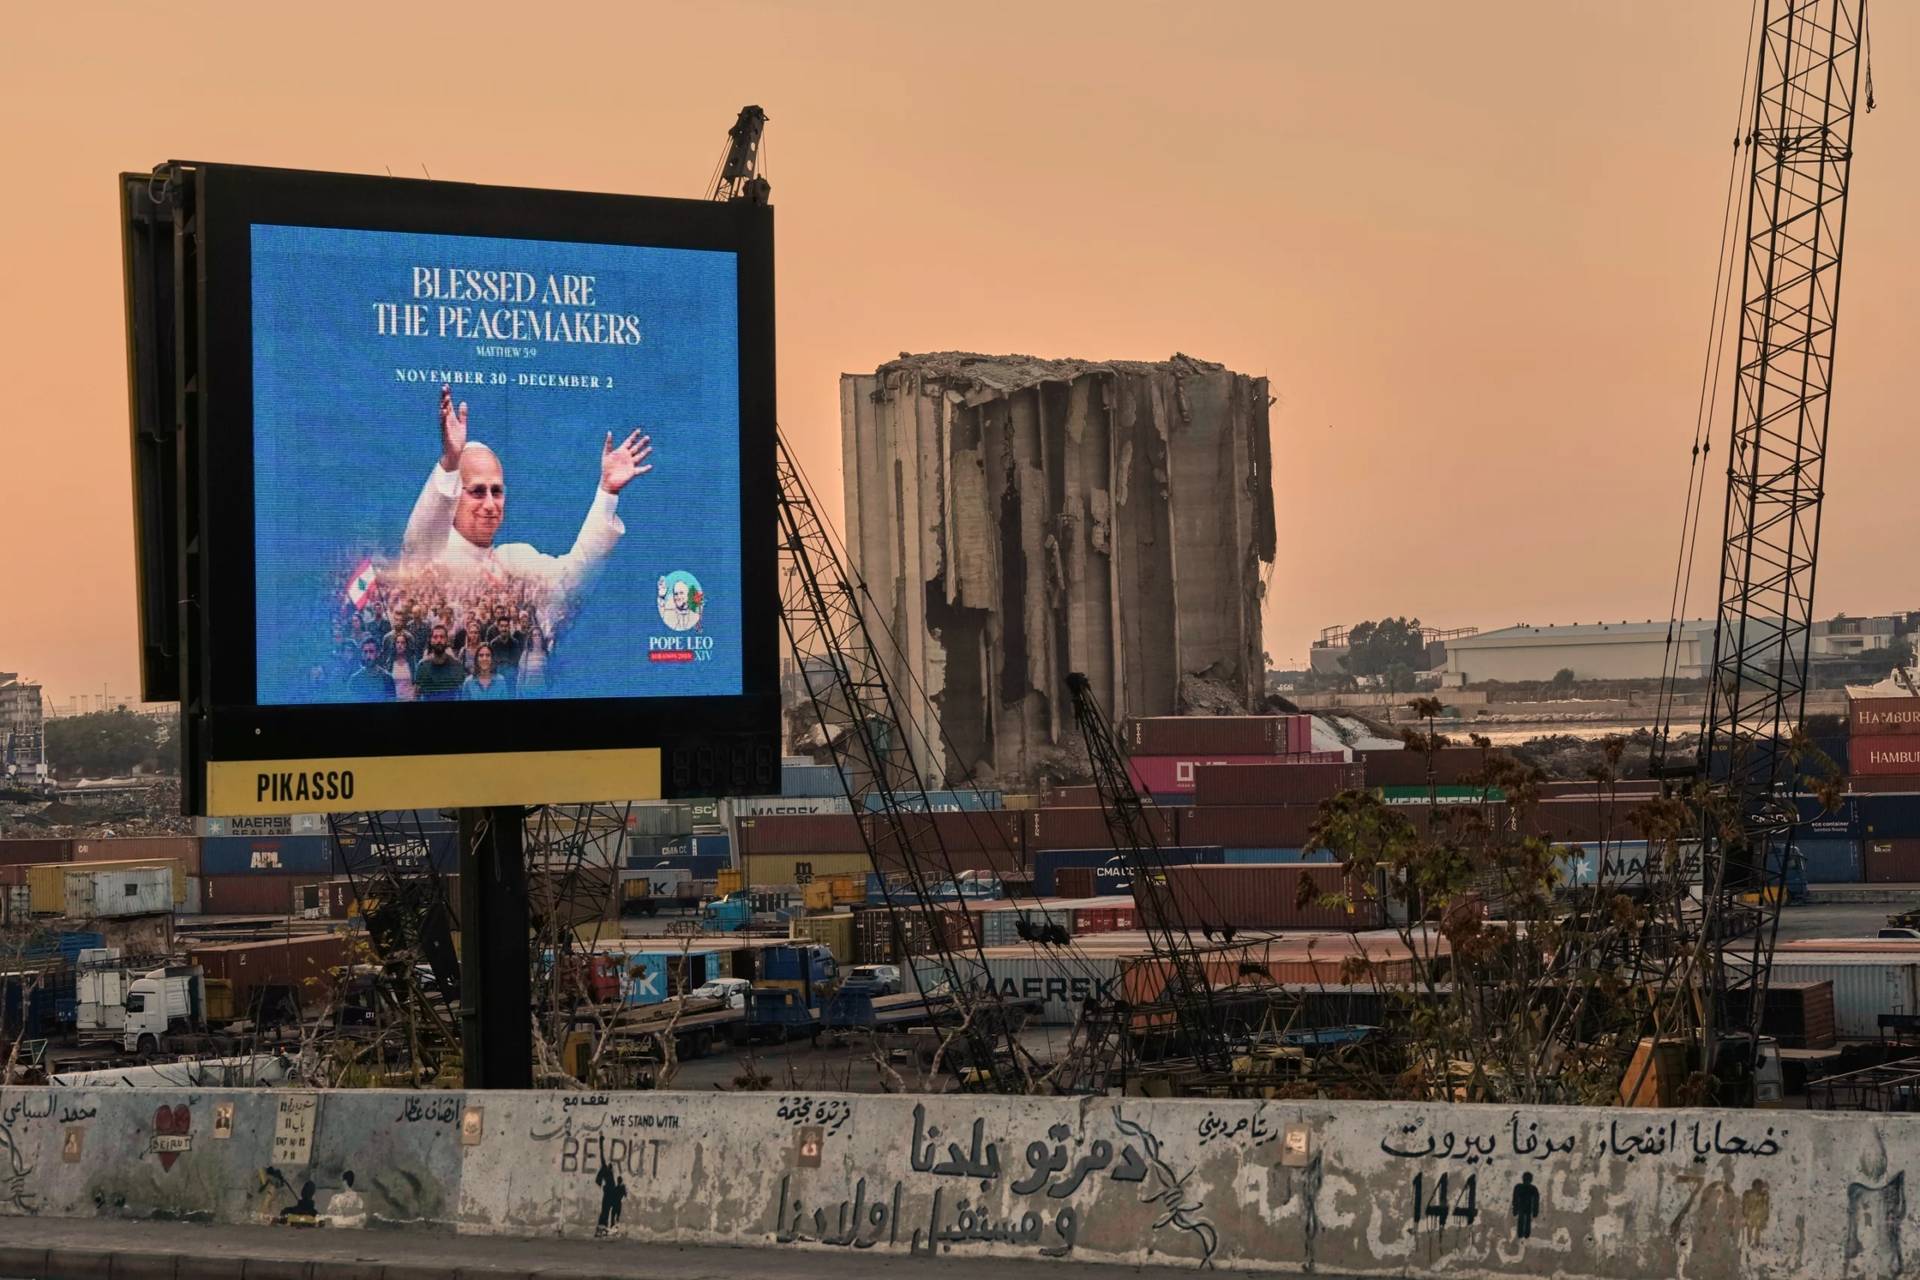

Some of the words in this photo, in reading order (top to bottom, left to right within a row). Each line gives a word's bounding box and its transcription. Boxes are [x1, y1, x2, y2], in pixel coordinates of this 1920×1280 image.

[413, 266, 536, 302] BLESSED
[541, 274, 596, 306] ARE
[373, 303, 428, 336] THE
[439, 306, 641, 345] PEACEMAKERS
[476, 346, 519, 358] MATTHEW
[395, 368, 484, 385] NOVEMBER
[490, 373, 507, 385] 30
[518, 374, 600, 388] DECEMBER
[605, 377, 614, 388] 2
[649, 636, 685, 650] POPE
[687, 636, 714, 650] LEO
[695, 650, 713, 661] XIV
[258, 770, 354, 802] PIKASSO
[231, 816, 291, 828] MAERSK
[1096, 867, 1120, 877] CMA
[59, 1106, 97, 1123] محمد
[610, 1115, 625, 1126] WE
[628, 1115, 654, 1127] STAND
[656, 1115, 679, 1128] WITH
[1252, 1112, 1279, 1146] ريتا
[911, 1102, 1001, 1192] بلدنا
[1381, 1116, 1496, 1164] بيروت
[1512, 1110, 1576, 1159] مرفأ
[1599, 1119, 1676, 1162] انفجار
[1692, 1119, 1780, 1163] ضحايا
[1011, 1122, 1149, 1198] دمرتو
[1412, 1172, 1479, 1226] 144
